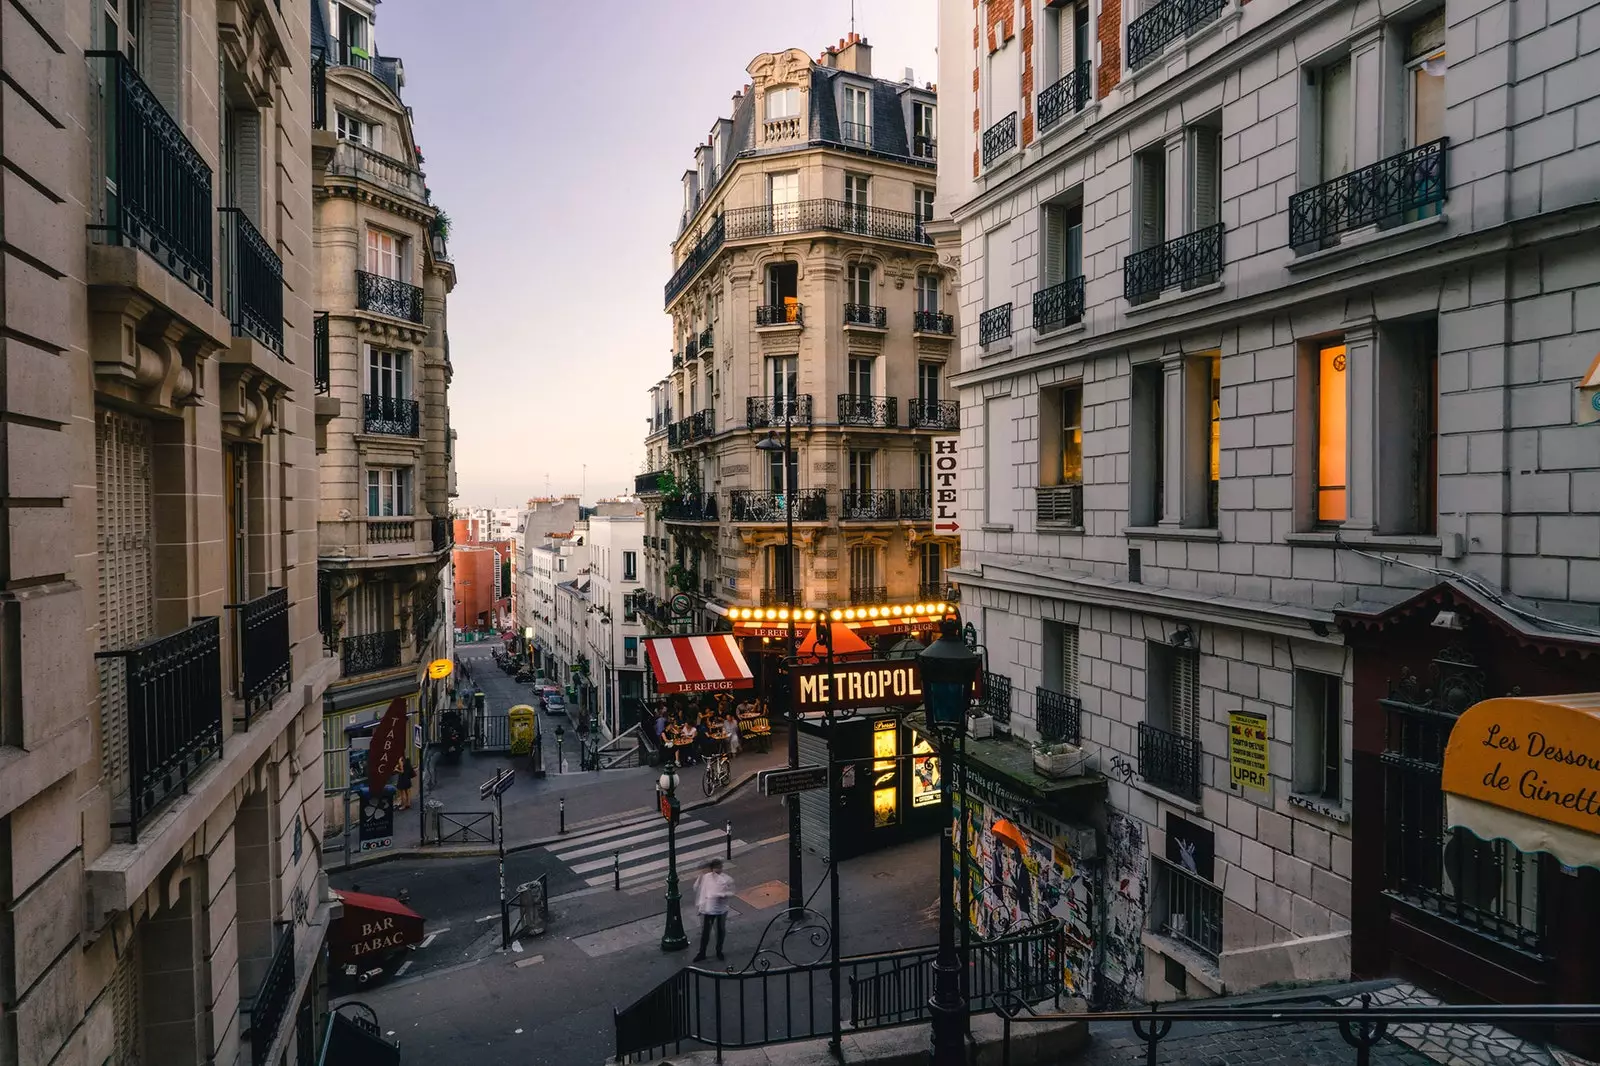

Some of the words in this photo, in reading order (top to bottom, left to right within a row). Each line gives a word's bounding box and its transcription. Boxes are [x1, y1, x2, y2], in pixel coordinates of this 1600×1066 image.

[935, 441, 957, 518] HOTEL
[754, 628, 765, 636] LE
[767, 629, 803, 637] REFUE
[893, 625, 903, 633] LE
[679, 683, 692, 692] LE
[694, 681, 733, 691] REFUGE
[378, 717, 399, 774] TABAC
[1482, 723, 1520, 752] Les
[1482, 762, 1511, 790] de
[362, 839, 392, 850] LOTO
[361, 917, 394, 936] BAR
[352, 931, 405, 956] TABAC
